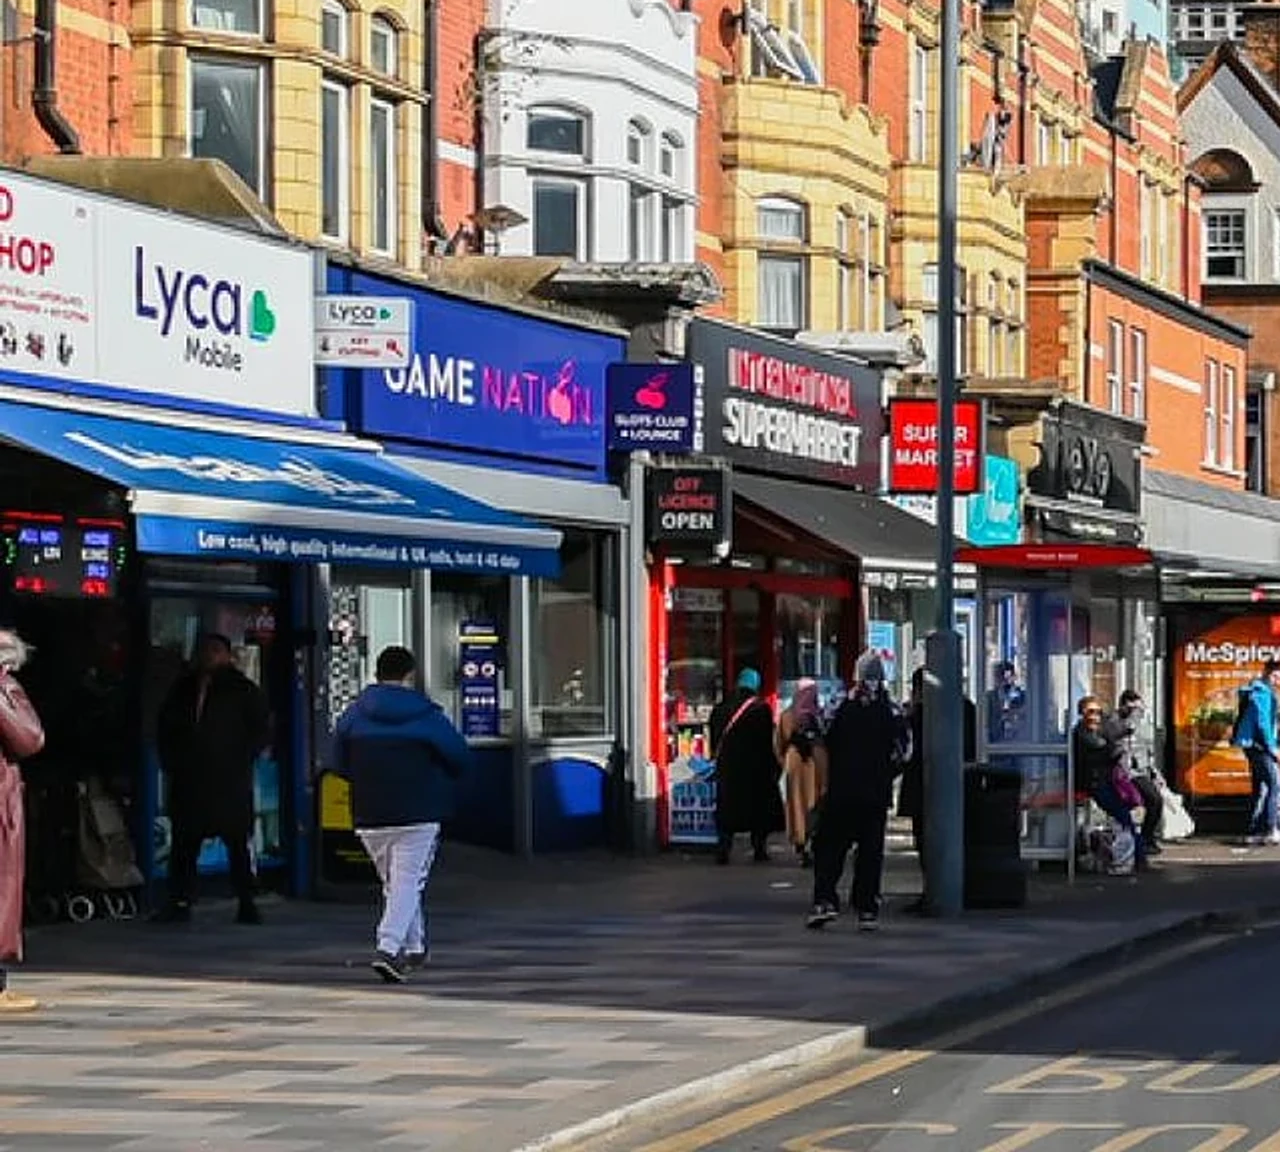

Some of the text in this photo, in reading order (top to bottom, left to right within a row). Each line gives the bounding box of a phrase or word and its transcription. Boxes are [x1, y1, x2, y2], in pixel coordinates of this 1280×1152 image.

[134, 246, 242, 336] Lyca
[329, 303, 376, 322] Lyca
[185, 335, 242, 372] Mobile
[902, 423, 968, 444] SUPR
[895, 448, 976, 466] MARET
[661, 512, 714, 530] OPEN
